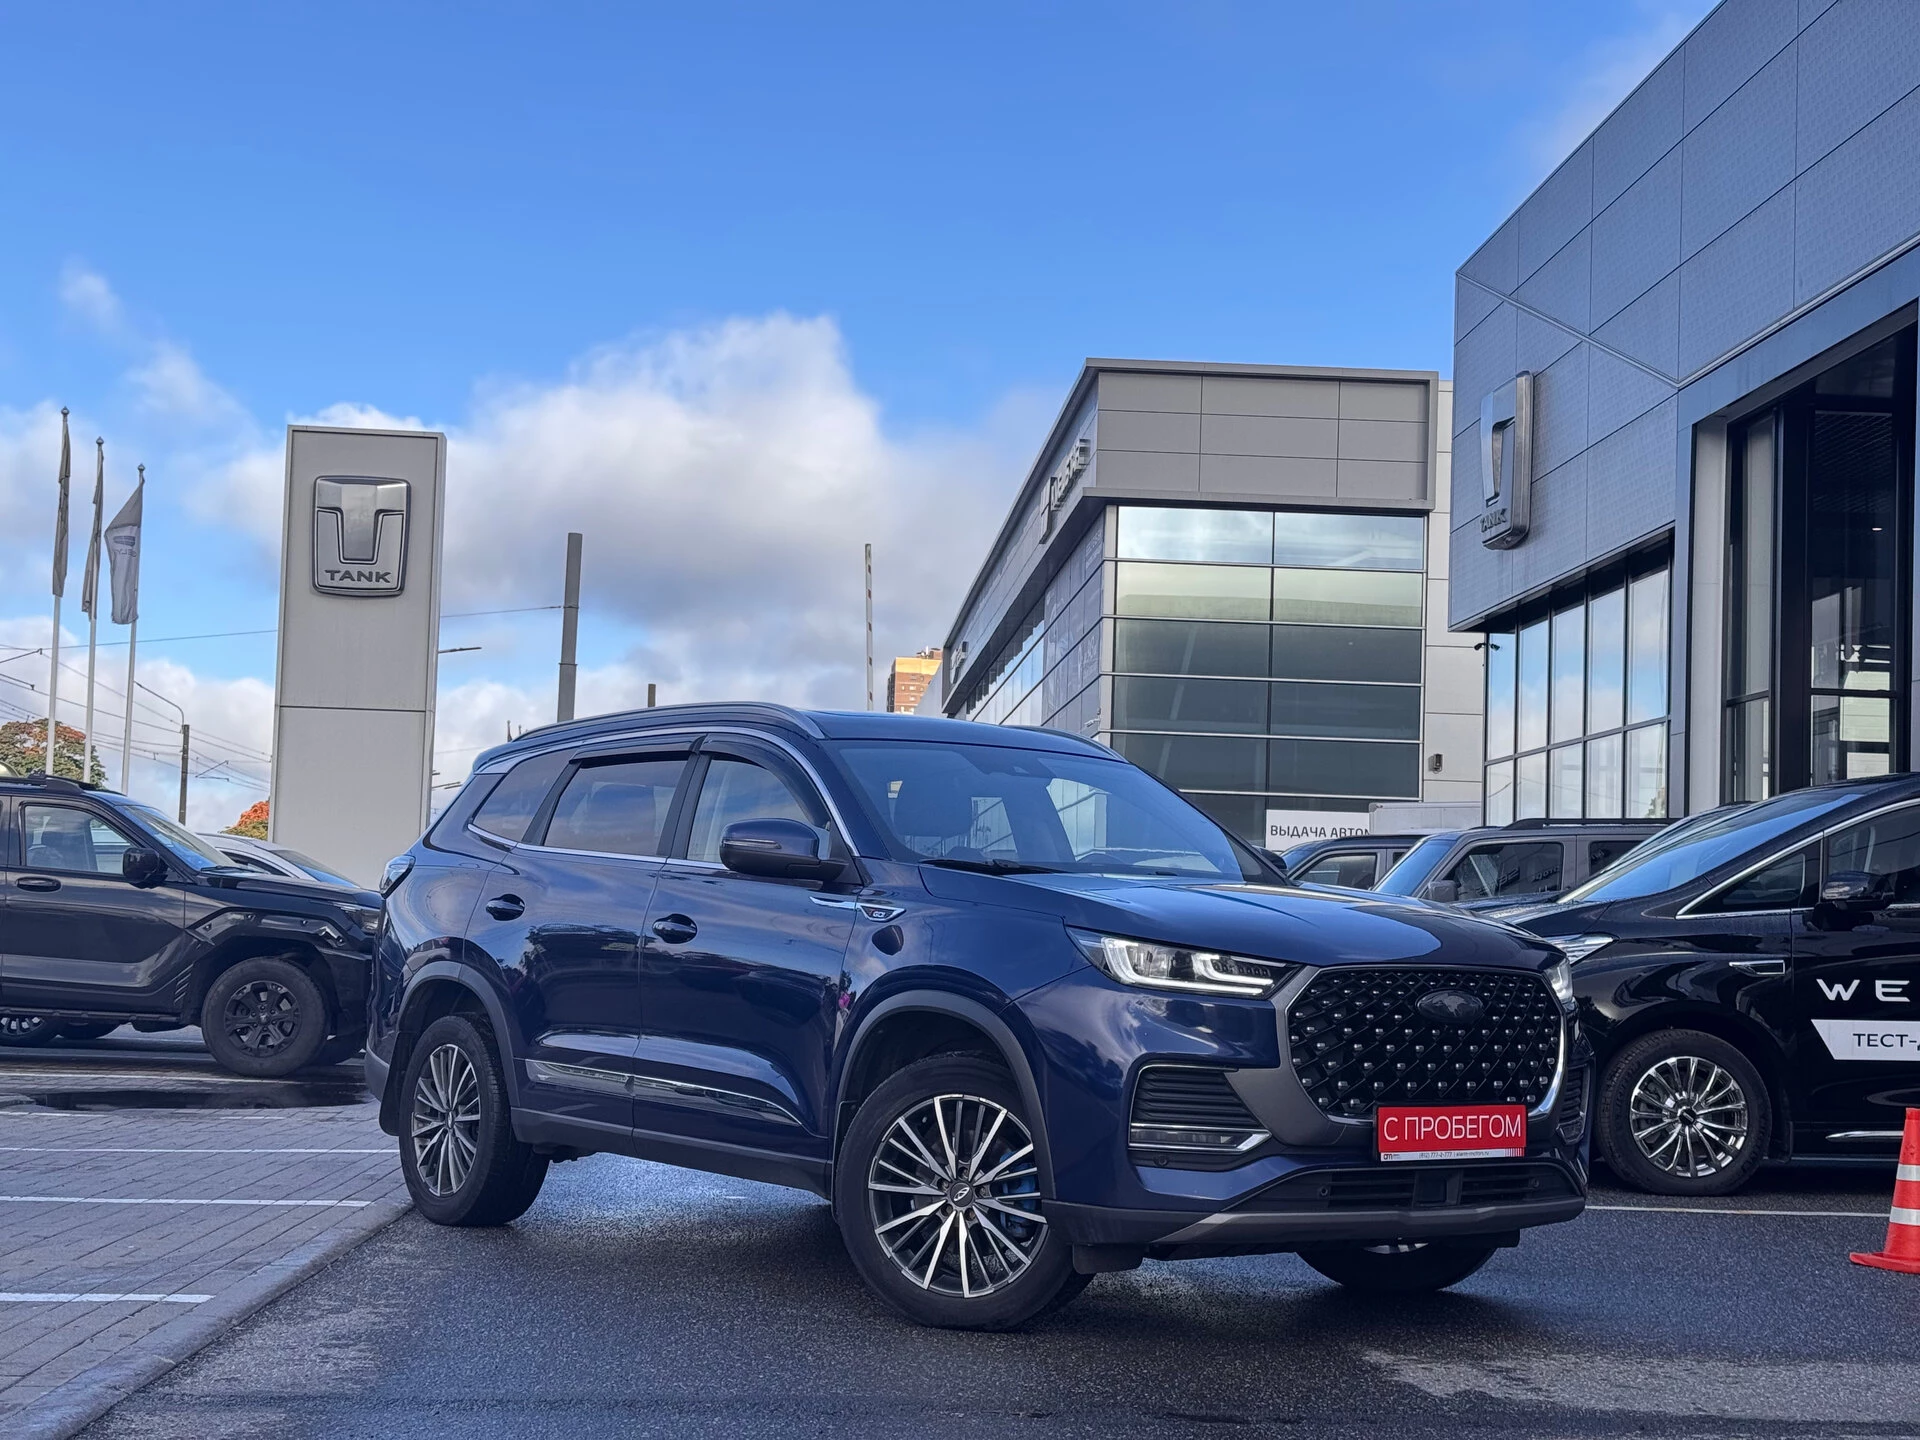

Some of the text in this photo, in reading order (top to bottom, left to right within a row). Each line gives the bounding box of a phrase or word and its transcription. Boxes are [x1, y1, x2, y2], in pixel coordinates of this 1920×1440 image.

[325, 569, 392, 583] TANK
[1270, 825, 1327, 838] ВЫДАЧА
[1852, 1033, 1920, 1051] ТЕСТ-
[1383, 1114, 1521, 1141] С ПРОБЕГОМ
